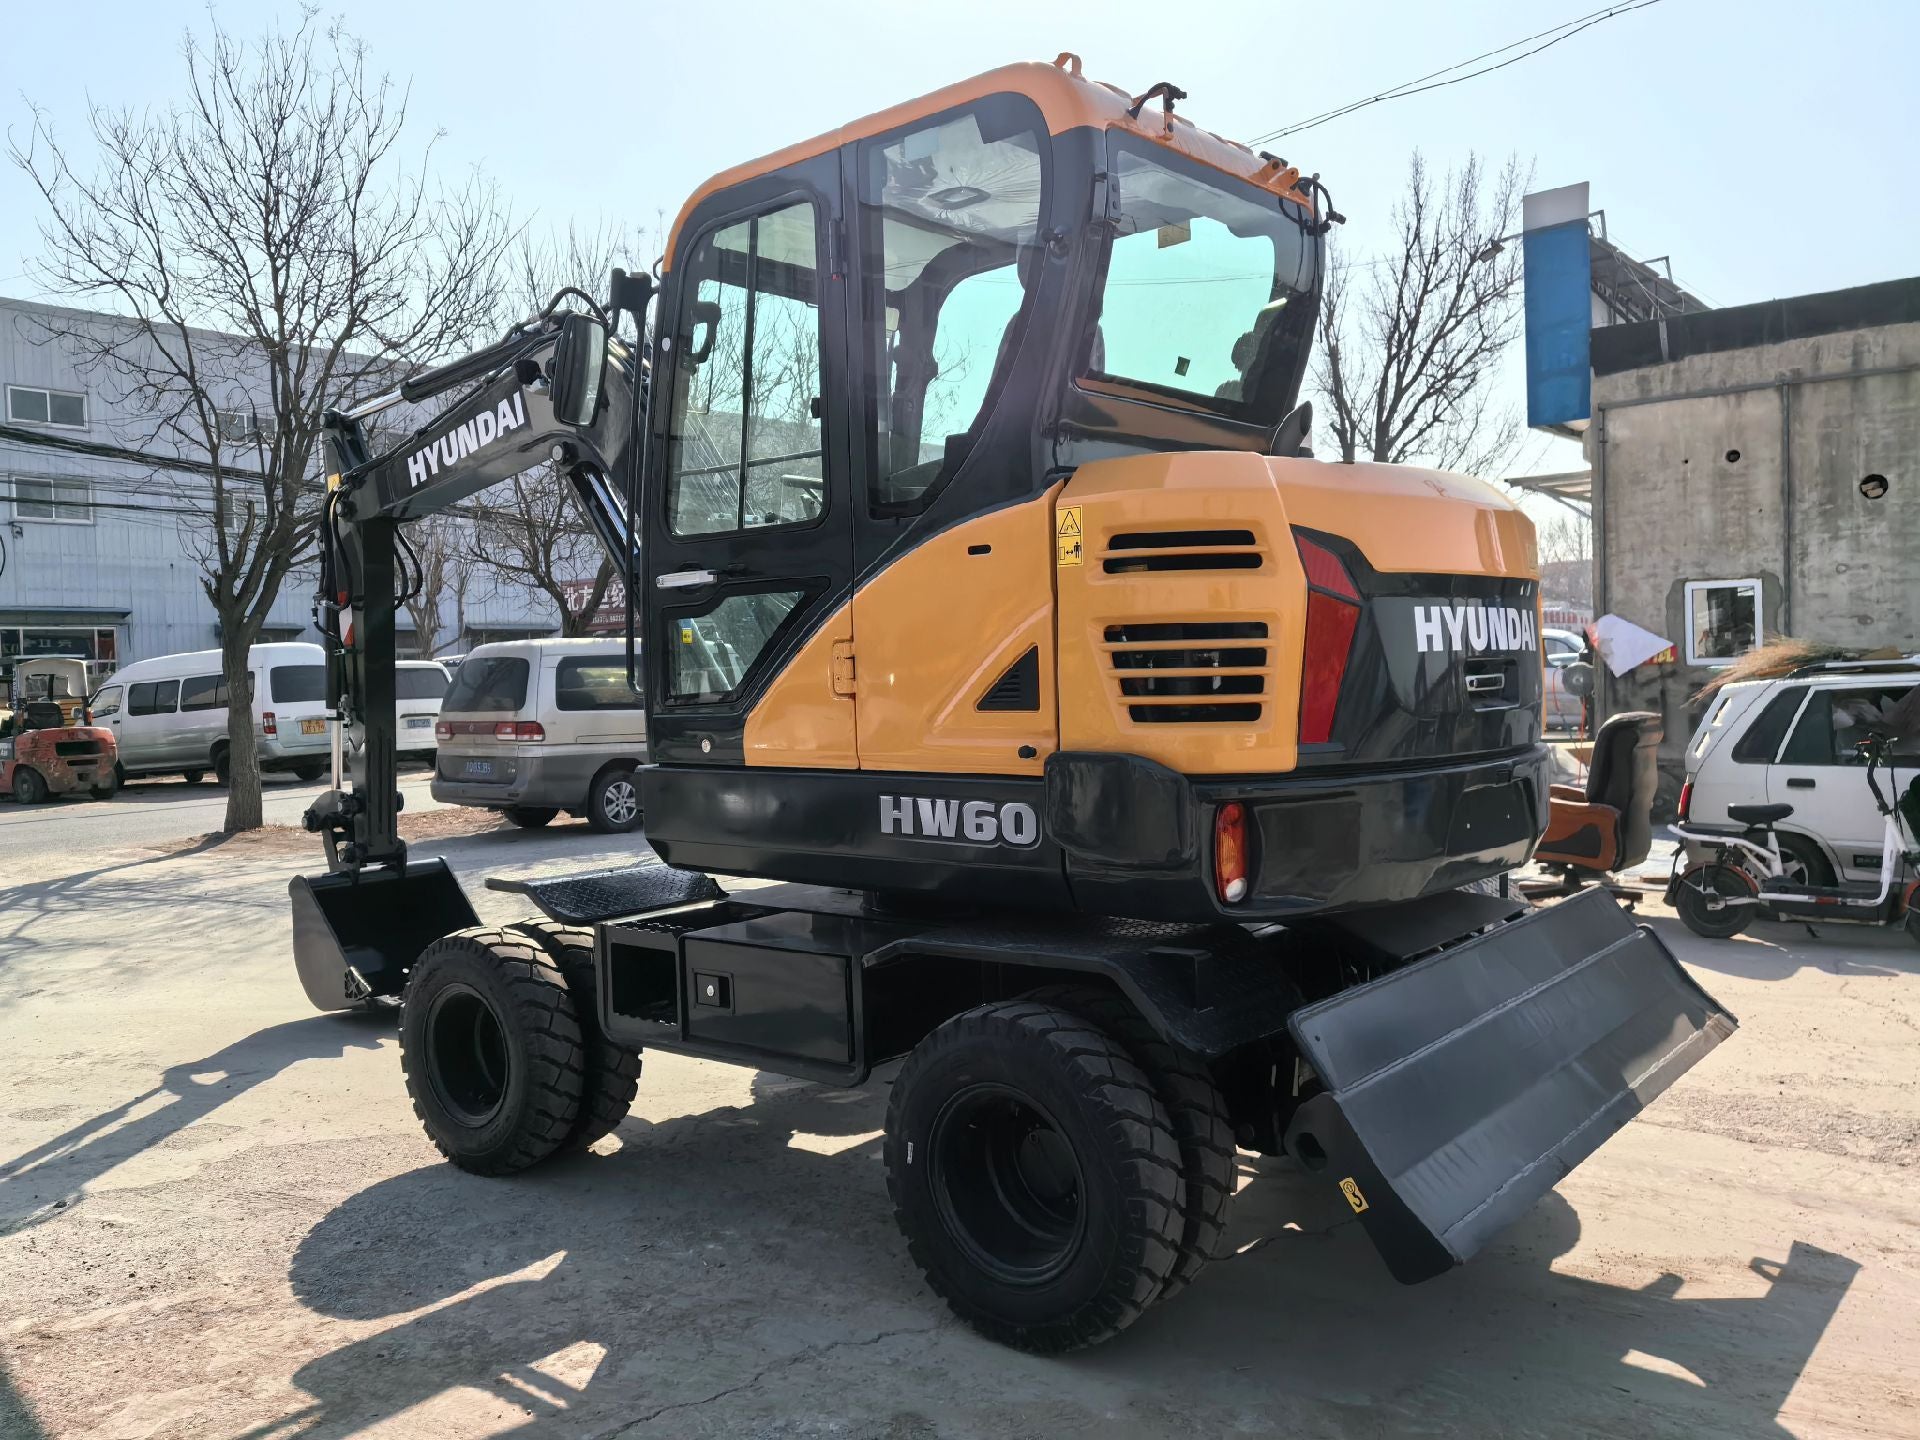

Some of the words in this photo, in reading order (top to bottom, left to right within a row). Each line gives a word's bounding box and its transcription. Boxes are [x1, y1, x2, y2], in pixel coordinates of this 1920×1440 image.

[407, 390, 525, 488] HYUNDAI
[1414, 606, 1537, 653] HYUNDAI
[880, 795, 1037, 845] HW60
